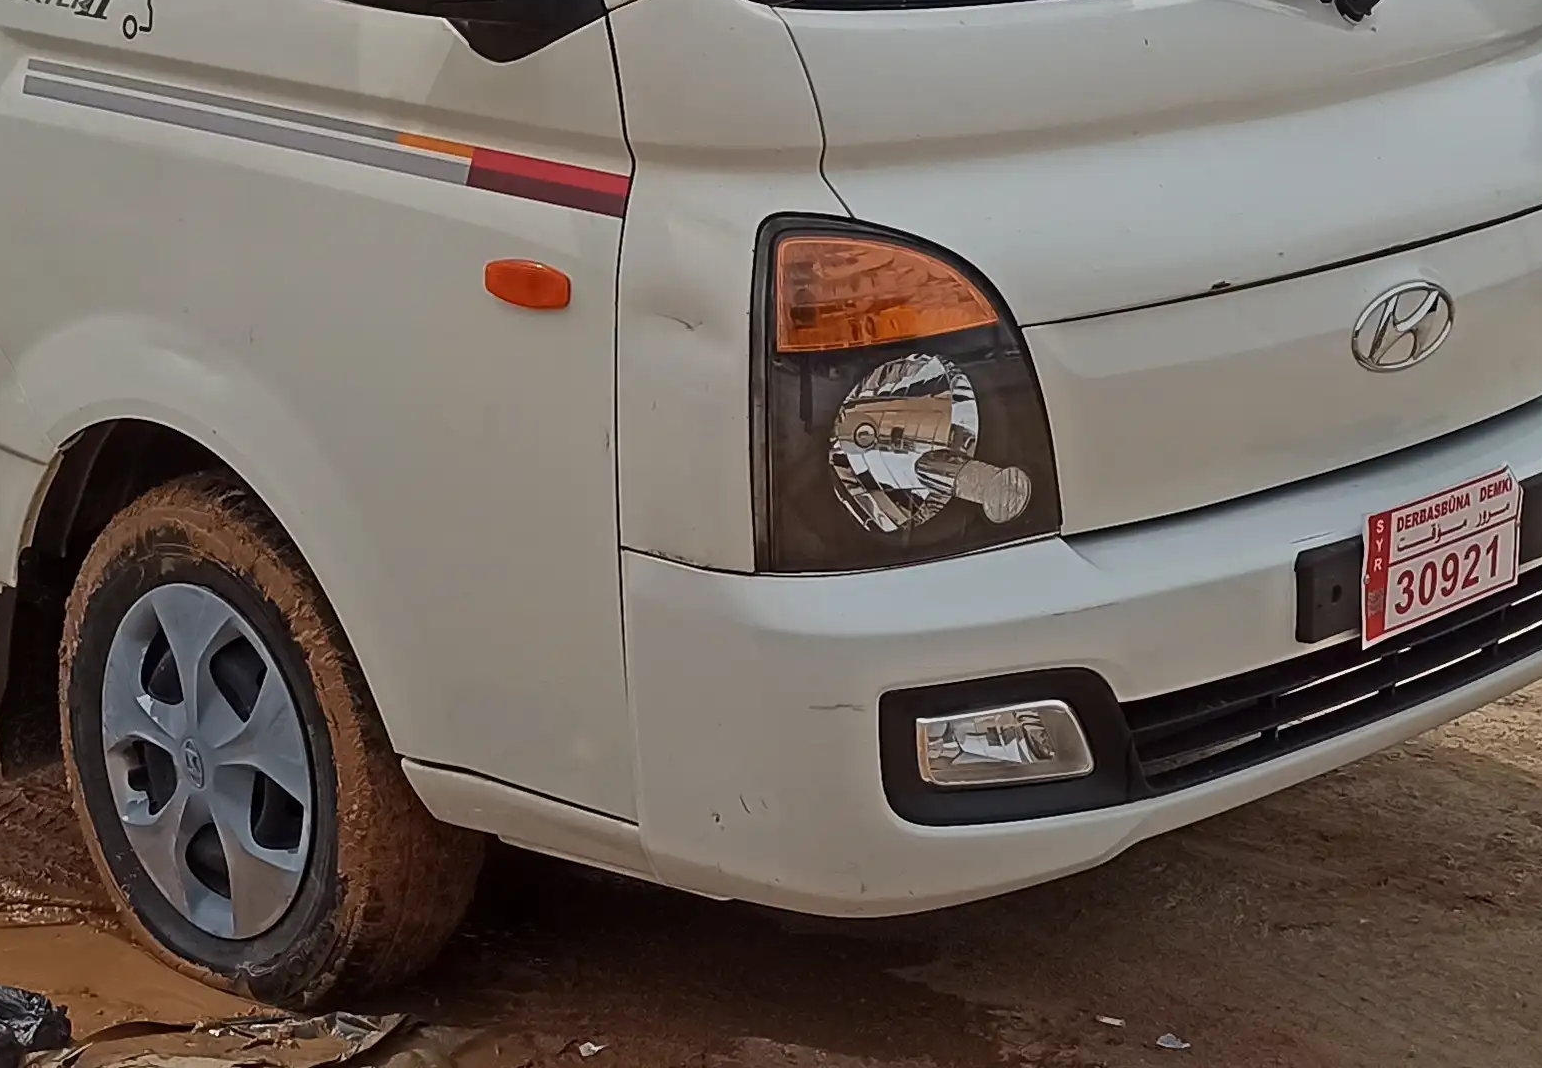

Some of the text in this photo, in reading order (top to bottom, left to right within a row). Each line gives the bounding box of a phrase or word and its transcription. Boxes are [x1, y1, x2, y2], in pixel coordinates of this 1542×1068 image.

[1397, 491, 1471, 532] DERBASBÛNA
[1397, 501, 1510, 552] مرور مؤقت
[1394, 534, 1500, 616] 30921
